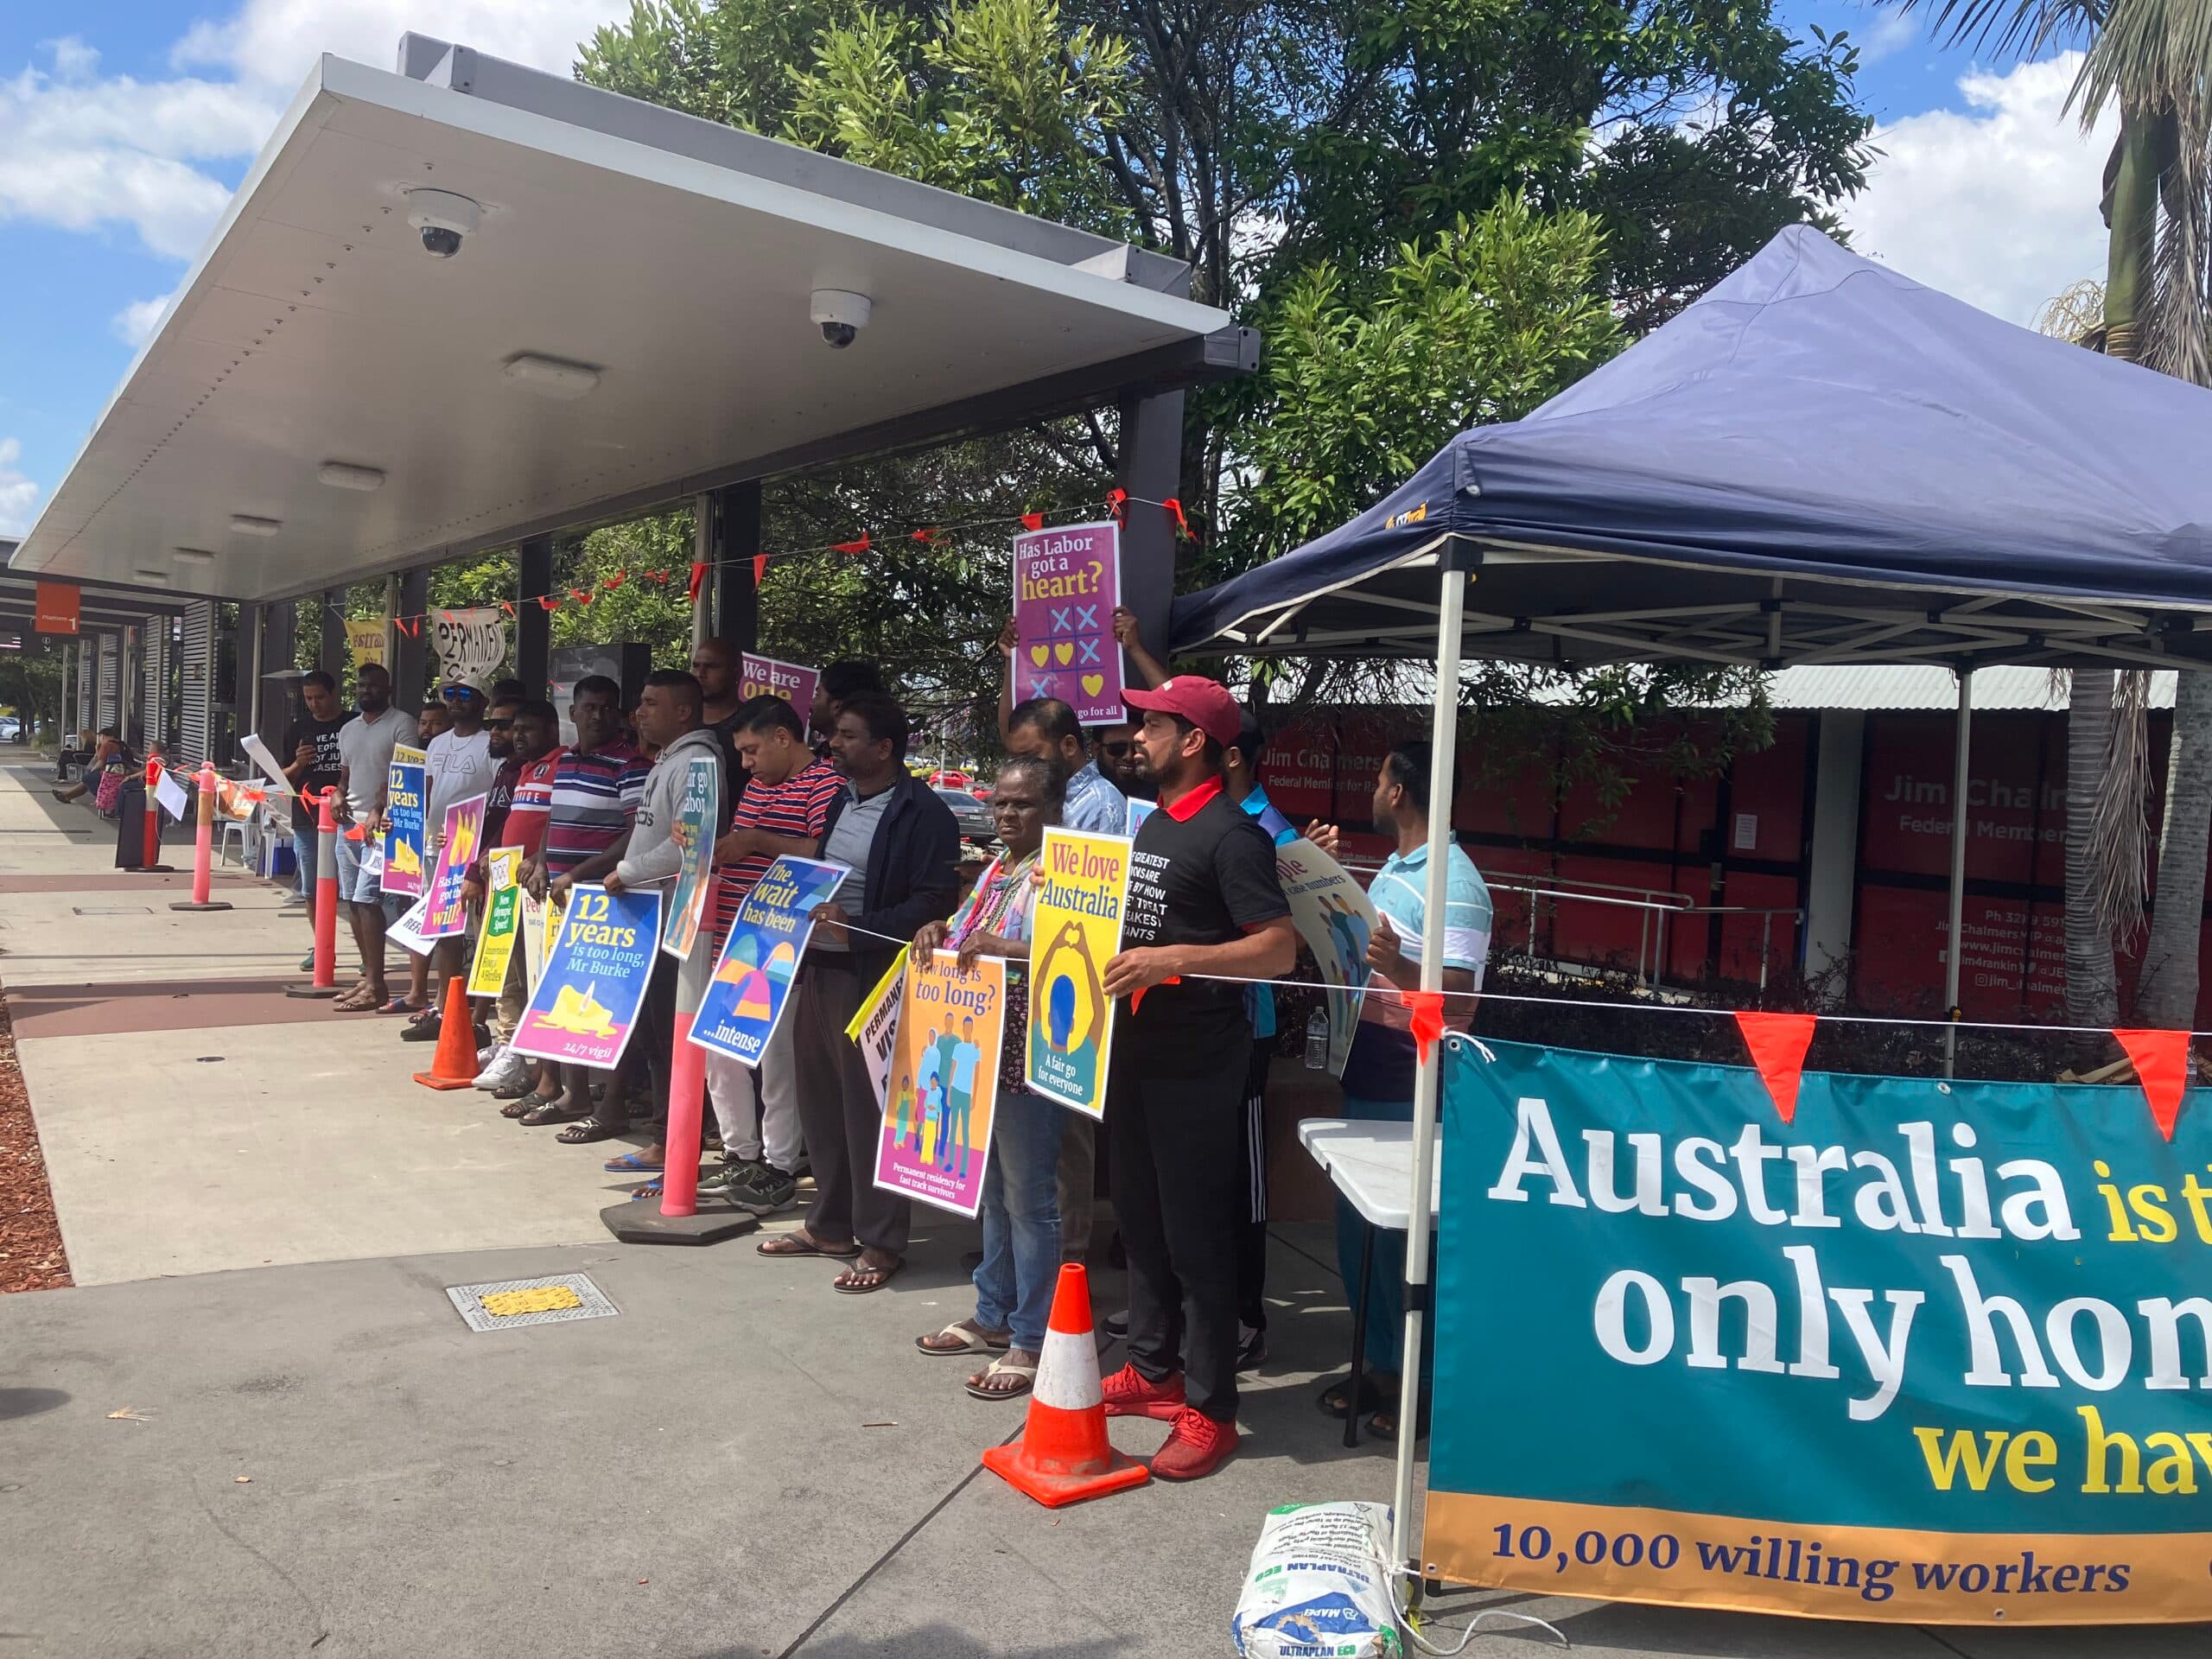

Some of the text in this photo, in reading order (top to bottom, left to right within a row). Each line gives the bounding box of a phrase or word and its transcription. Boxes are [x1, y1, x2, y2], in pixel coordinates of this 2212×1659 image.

[1019, 536, 1093, 560] Has Labor
[1032, 556, 1069, 579] got a
[1021, 561, 1103, 601] heart?
[69, 617, 76, 631] 1
[743, 661, 800, 688] We are
[1077, 705, 1118, 719] go for all
[317, 741, 340, 753] EOPL
[1262, 747, 1291, 767] Jim
[314, 762, 343, 772] ASES
[407, 754, 425, 764] yea
[432, 753, 477, 774] FILA
[391, 769, 404, 788] 12
[1268, 775, 1301, 788] Federal
[389, 790, 418, 810] years
[1885, 775, 1945, 804] Jim
[393, 807, 399, 817] is
[400, 808, 410, 817] too
[683, 791, 705, 812] abor
[1900, 816, 1969, 836] Federl
[1052, 842, 1120, 882] We love
[438, 871, 465, 887] Has Bur
[767, 865, 792, 883] The
[1305, 874, 1346, 891] numbers
[439, 887, 461, 904] got th
[753, 881, 799, 908] wait
[1039, 877, 1119, 920] Australia
[1134, 882, 1143, 893] BY
[1144, 885, 1166, 900] HOW
[433, 901, 462, 926] will?
[575, 894, 609, 921] 12
[742, 903, 796, 933] has been
[1127, 912, 1161, 927] EAKES
[1986, 910, 2001, 922] Ph
[2044, 917, 2066, 929] 591
[565, 922, 636, 948] years
[573, 943, 645, 968] is too long,
[1961, 958, 2018, 973] im4rankin
[567, 958, 630, 978] Mr Burke
[939, 961, 967, 984] long
[971, 965, 982, 982] is
[916, 980, 995, 1016] too long?
[865, 975, 905, 1044] PERMANE
[563, 1042, 613, 1058] 24/7 vigil
[1045, 1054, 1076, 1078] A fair go
[1038, 1066, 1084, 1096] for everyone
[893, 1162, 966, 1191] Permanent residency for
[1488, 1096, 2080, 1243] Australia
[2094, 1160, 2179, 1243] is
[899, 1174, 956, 1199] fast track survivors
[1593, 1245, 1924, 1421] only
[1913, 1426, 2057, 1493] we
[1492, 1522, 2130, 1601] 10,000 willing workers
[1255, 1562, 1370, 1584] ULTRAPLAN ECO
[1304, 1608, 1340, 1618] MAPEI
[1279, 1644, 1356, 1656] ULTRAPLAN ECO
